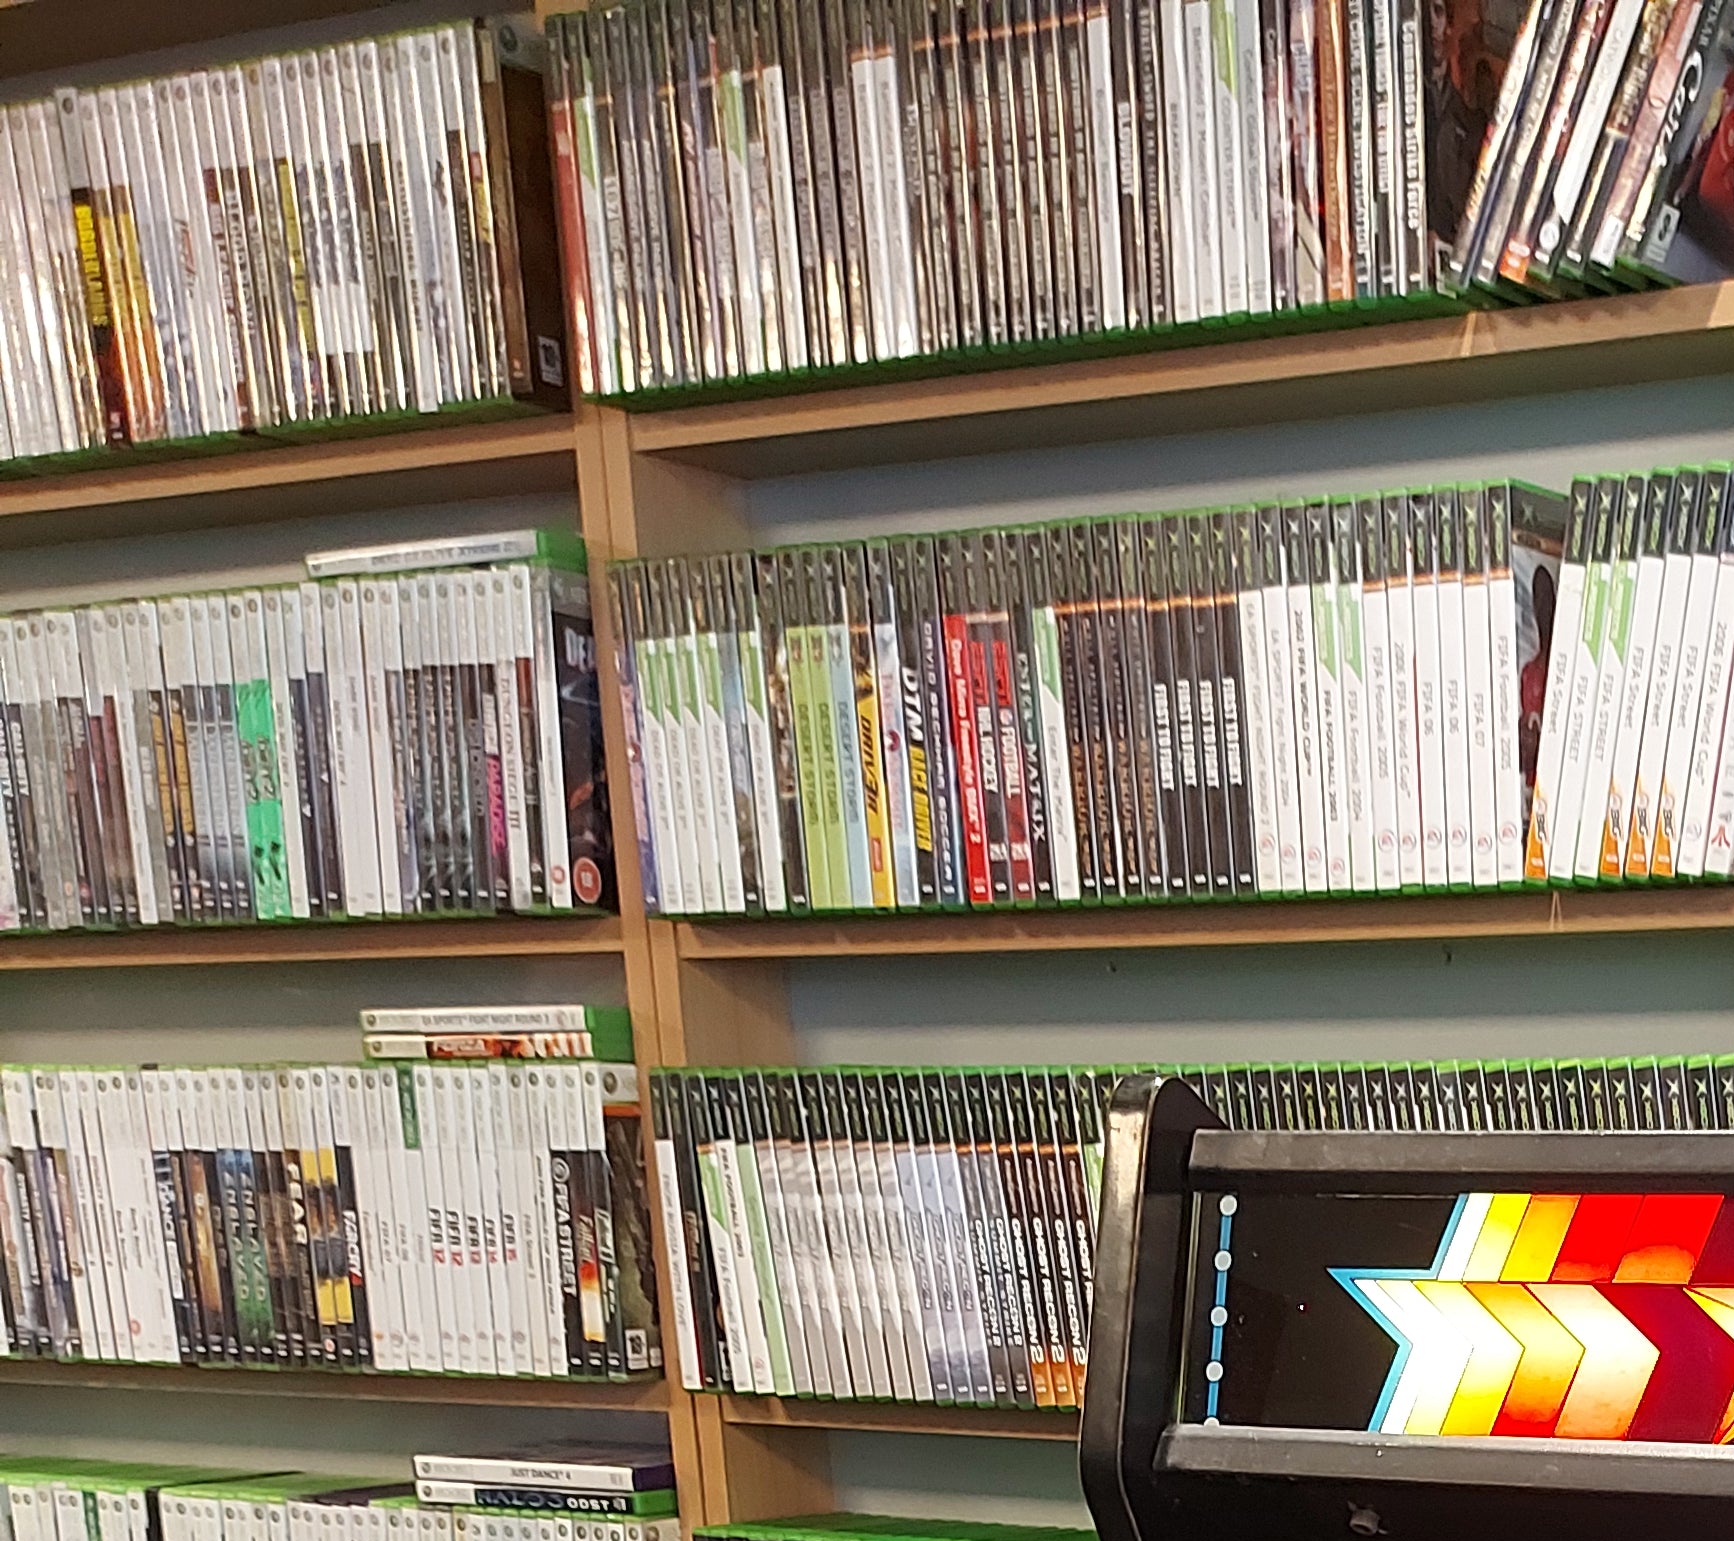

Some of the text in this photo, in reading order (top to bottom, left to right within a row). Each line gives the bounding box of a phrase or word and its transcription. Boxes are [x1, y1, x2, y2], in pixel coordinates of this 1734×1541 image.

[901, 667, 924, 741] DTM
[1032, 1217, 1065, 1364] GHOST RECON 2
[1054, 1218, 1086, 1366] GHOST RECON 2
